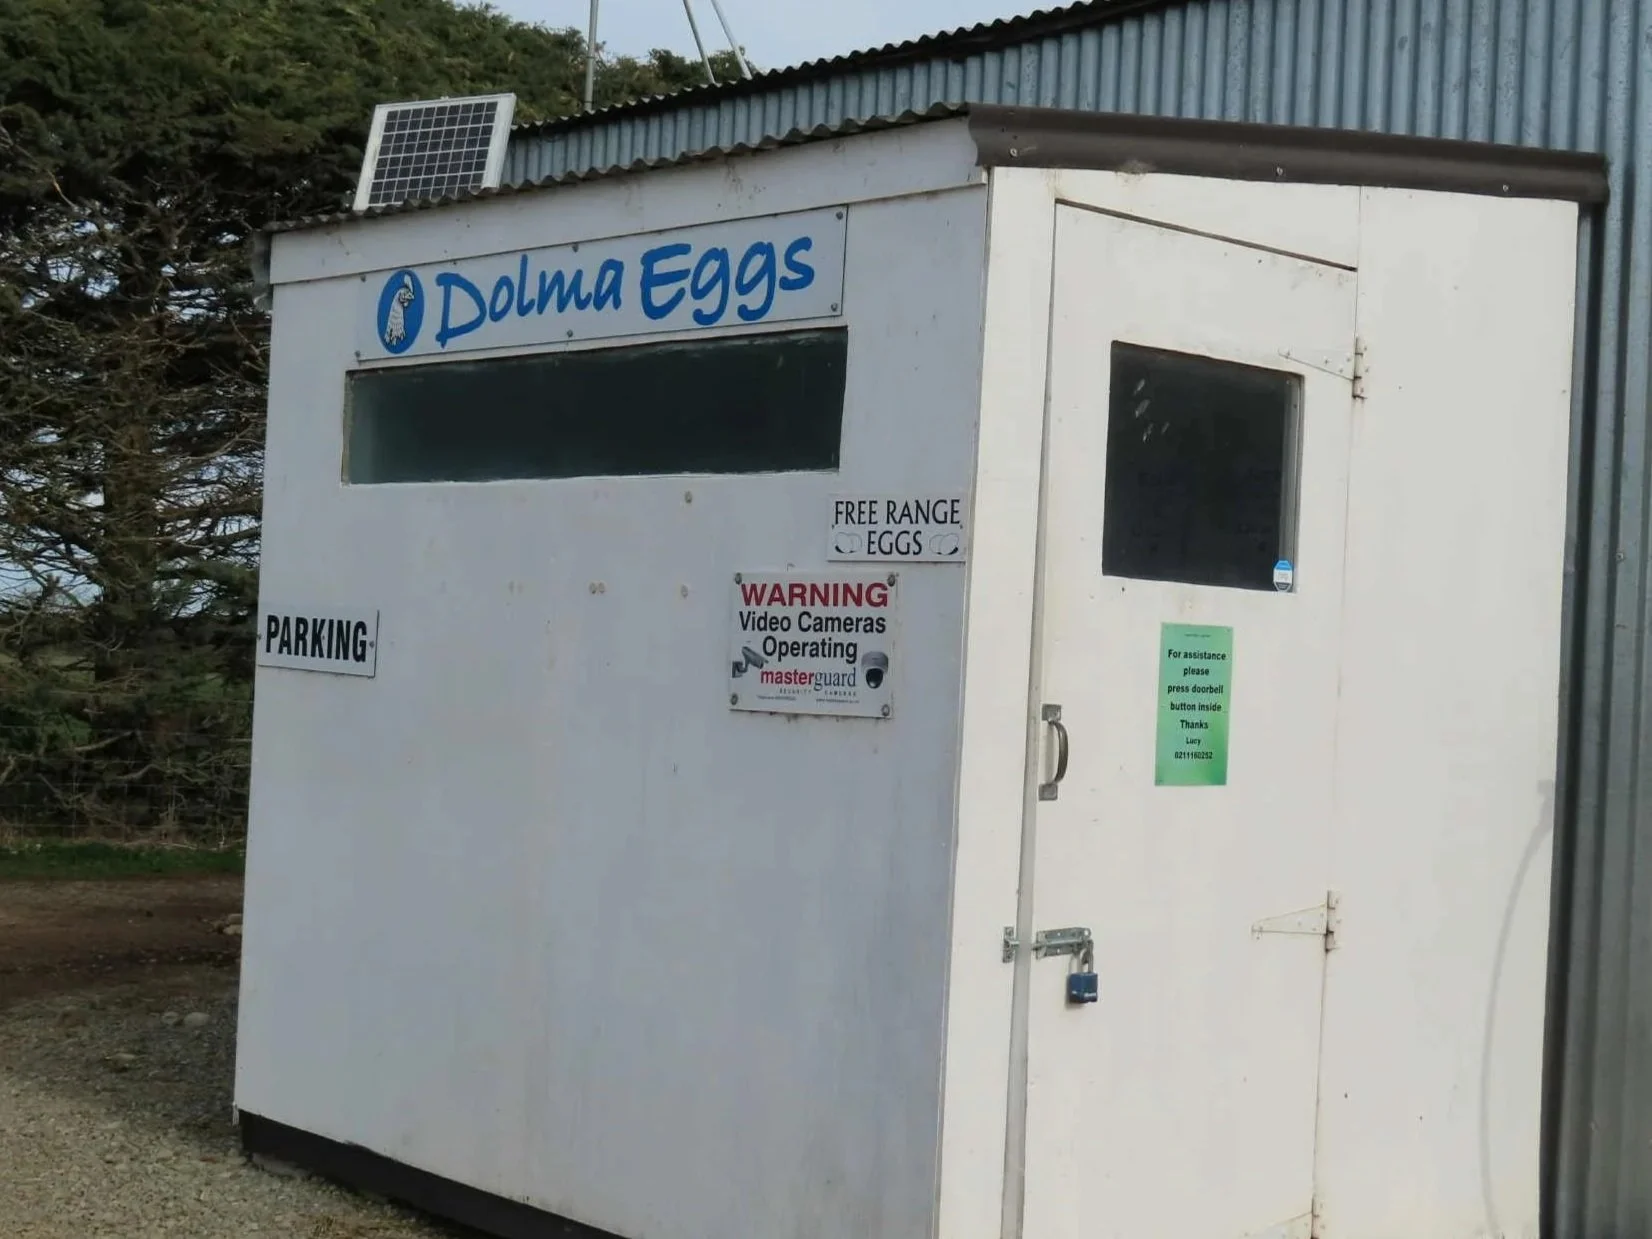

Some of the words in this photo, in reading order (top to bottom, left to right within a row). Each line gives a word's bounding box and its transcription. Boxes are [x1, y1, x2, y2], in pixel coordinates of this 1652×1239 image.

[435, 254, 624, 347] Dolma
[640, 235, 815, 325] Eggs
[834, 500, 878, 525] FREE
[886, 499, 961, 525] RANGE
[867, 530, 923, 555] EGGS
[741, 583, 889, 607] WARNING
[739, 611, 791, 632] Video
[798, 611, 886, 633] Cameras
[266, 614, 367, 663] PARKING
[762, 635, 857, 664] Operating
[1168, 649, 1181, 660] For
[1183, 650, 1226, 661] assistance
[760, 667, 856, 692] masterguard
[1183, 666, 1210, 677] please
[1167, 684, 1190, 694] press
[1191, 684, 1223, 694] doorbell
[1170, 702, 1196, 712] button
[1198, 702, 1222, 712] inside
[1180, 720, 1209, 730] Thanks
[1186, 737, 1201, 746] Lucy
